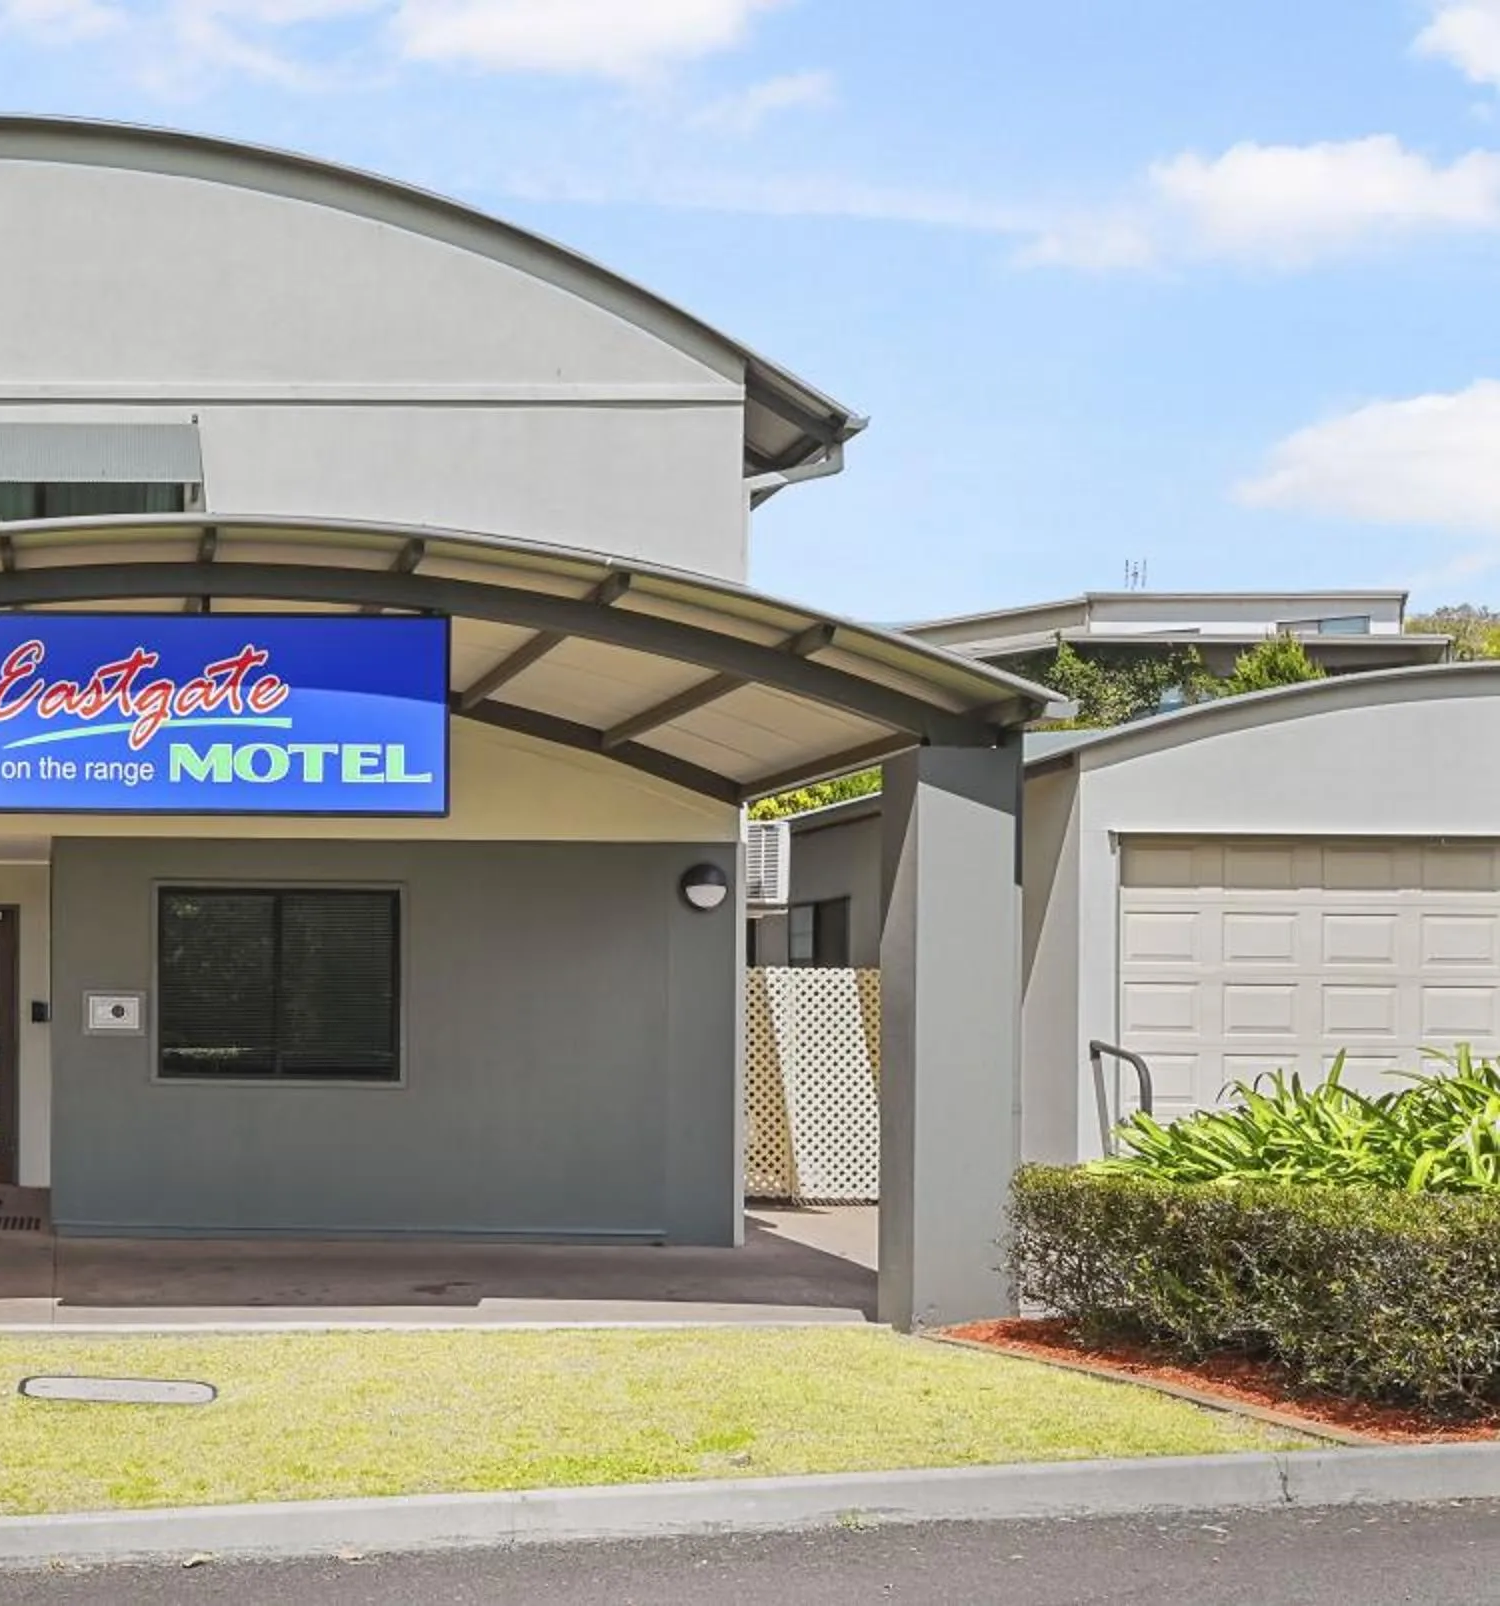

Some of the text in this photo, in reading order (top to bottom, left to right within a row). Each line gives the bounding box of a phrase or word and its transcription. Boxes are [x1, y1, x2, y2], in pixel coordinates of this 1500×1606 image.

[1, 756, 154, 786] on the range
[169, 743, 432, 783] MOTEL
